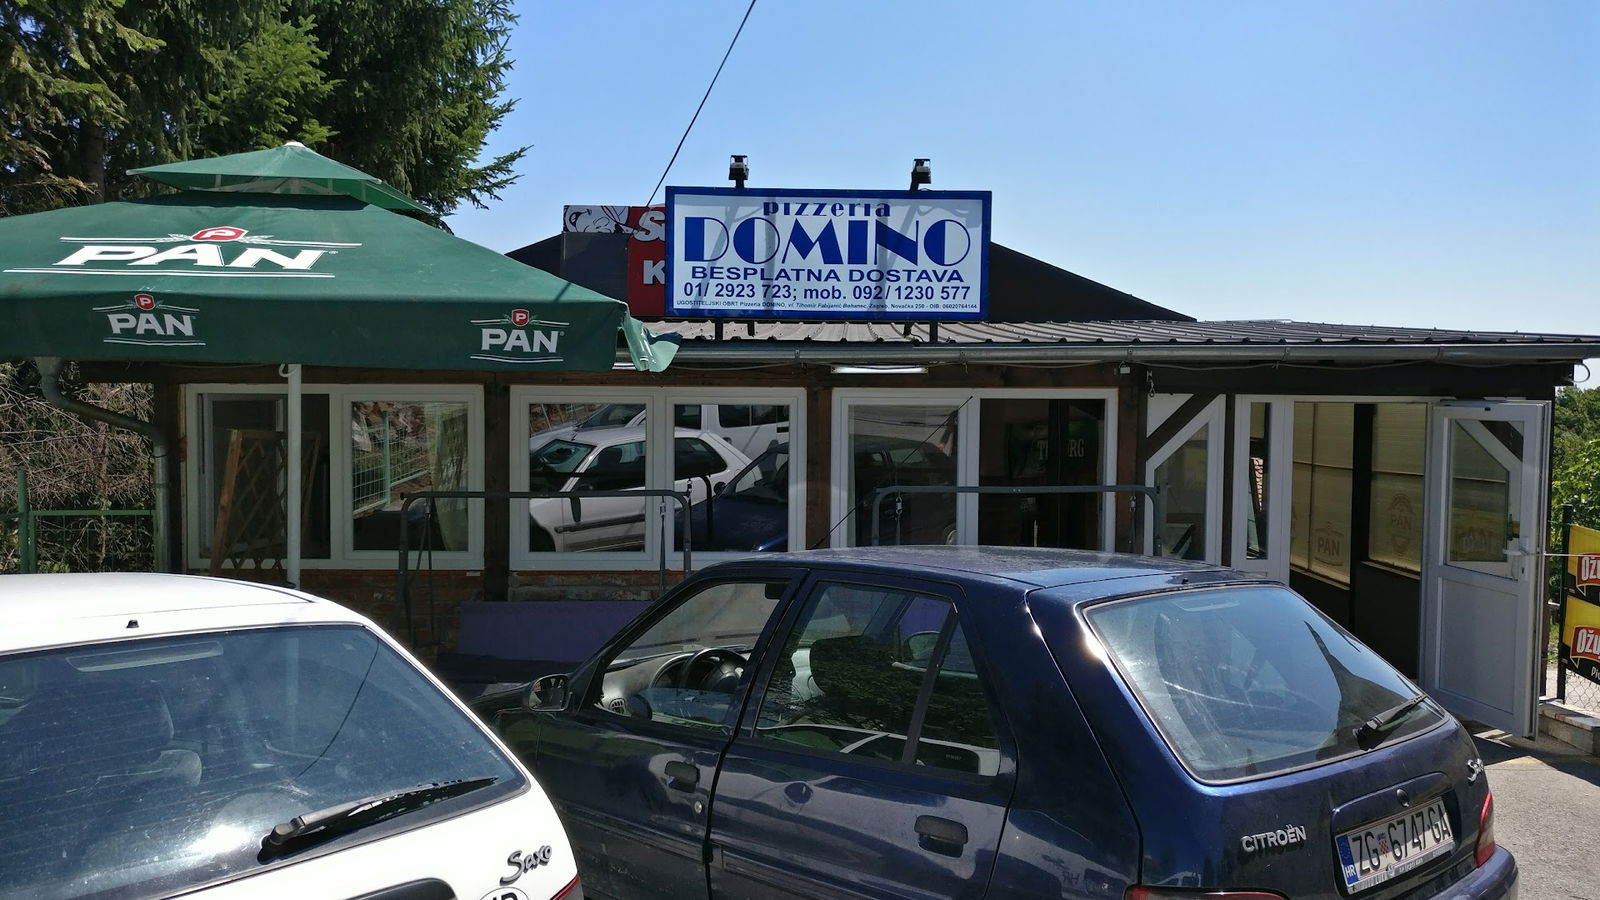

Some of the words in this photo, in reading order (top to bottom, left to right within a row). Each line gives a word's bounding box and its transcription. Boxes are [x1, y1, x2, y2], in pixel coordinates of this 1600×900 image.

[763, 201, 891, 217] pizzeria
[684, 216, 971, 267] DOMINO
[51, 243, 329, 270] PAN
[691, 266, 842, 283] BESPLATNA
[848, 269, 965, 283] DOSTAVA
[684, 282, 710, 297] 01/
[715, 282, 756, 298] 2923
[761, 284, 797, 301] 723;
[803, 285, 847, 300] mob.
[940, 286, 971, 300] 577
[107, 312, 195, 337] PAN
[481, 328, 559, 353] PAN
[1317, 536, 1341, 558] PAN
[1240, 823, 1307, 853] CITROËN
[499, 845, 553, 887] Saxo
[1352, 831, 1381, 876] ZG
[1344, 866, 1357, 878] HR
